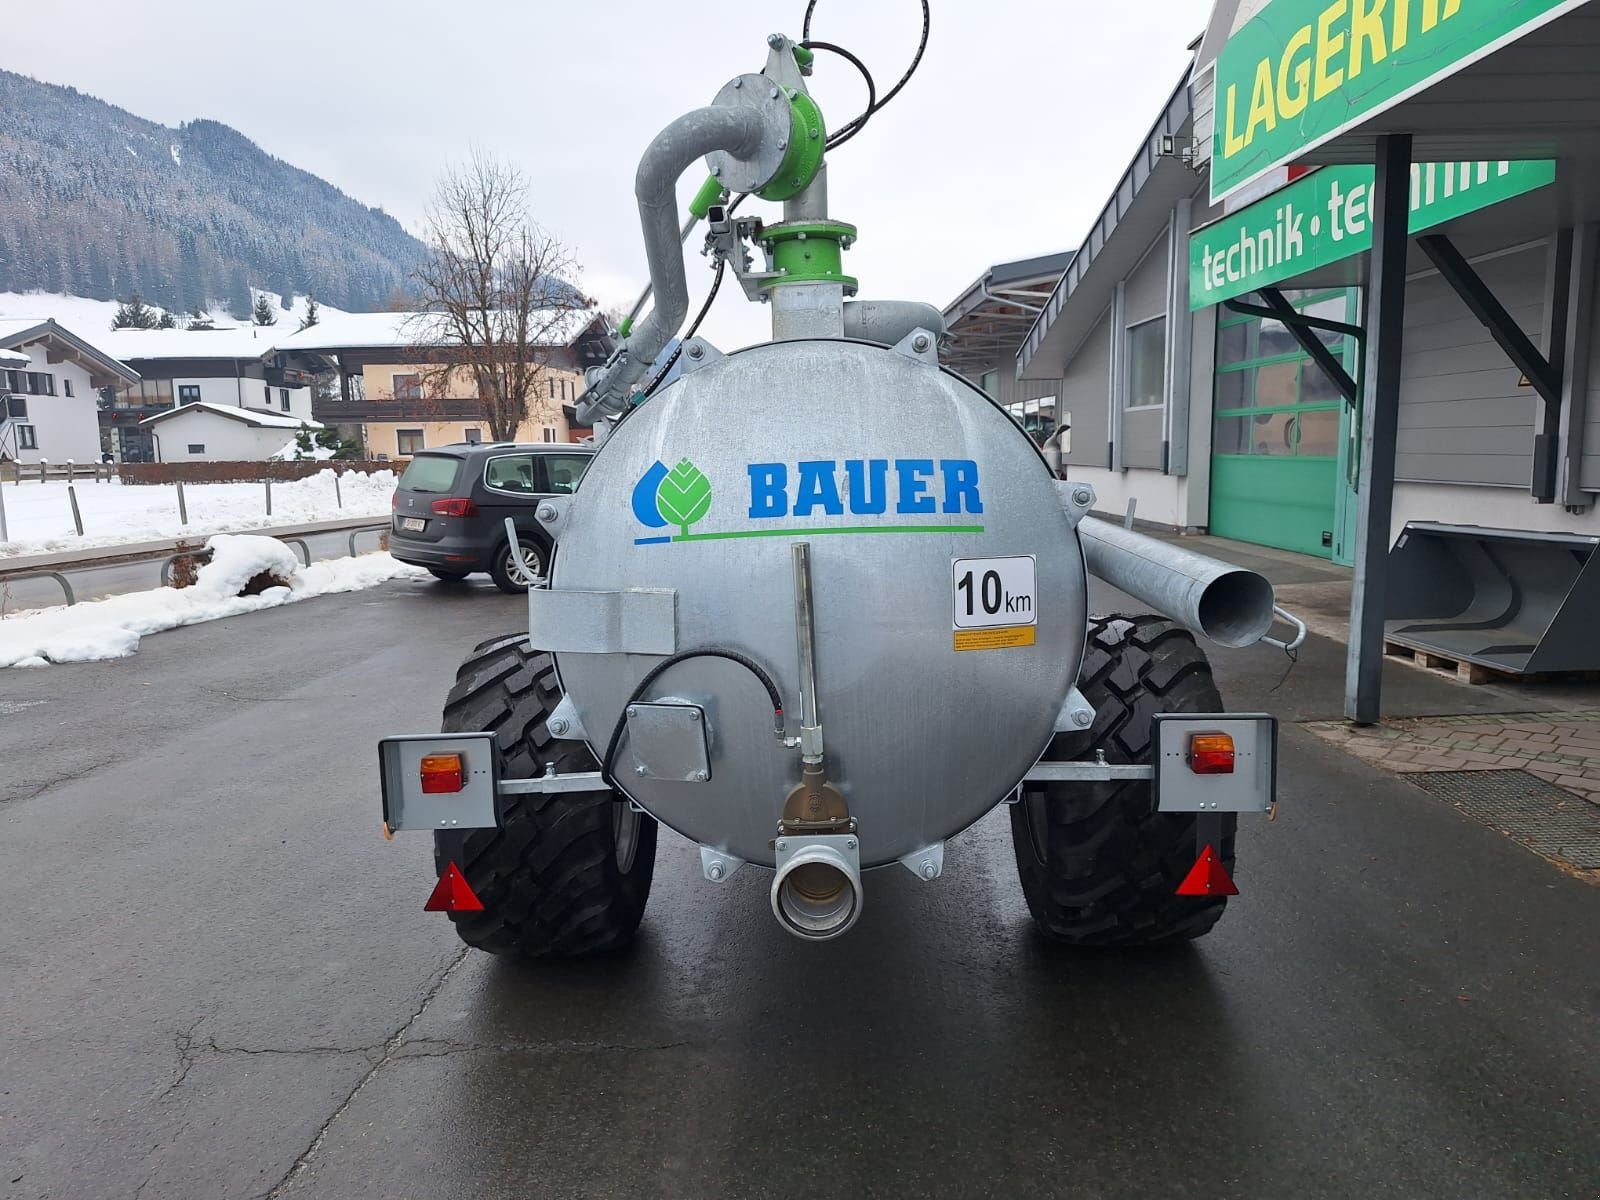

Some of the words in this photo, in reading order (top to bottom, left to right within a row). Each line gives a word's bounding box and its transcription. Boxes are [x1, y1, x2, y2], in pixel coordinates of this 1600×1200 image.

[1224, 0, 1461, 160] LAGER
[1202, 203, 1304, 291] technik
[747, 459, 985, 519] BAUER
[958, 570, 1002, 616] 10
[1005, 590, 1031, 613] km
